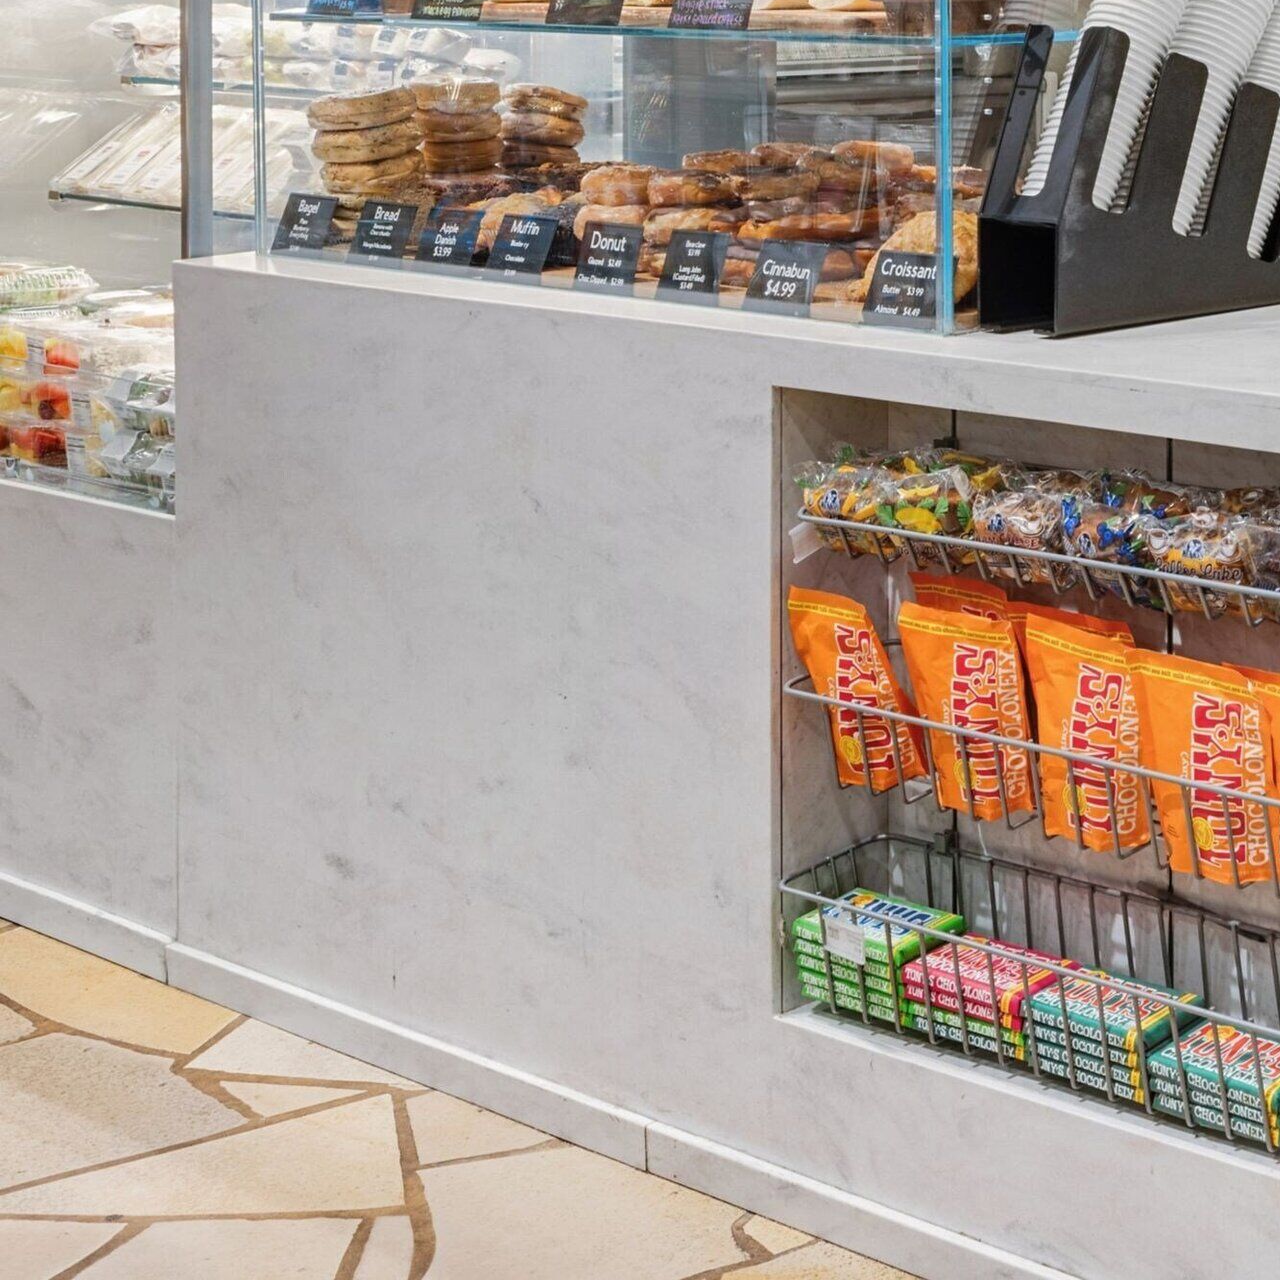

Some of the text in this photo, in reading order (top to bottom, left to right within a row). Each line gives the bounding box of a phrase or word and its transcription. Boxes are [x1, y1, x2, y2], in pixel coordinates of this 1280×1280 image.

[299, 200, 320, 217] Bagel
[374, 206, 400, 222] Bread
[439, 222, 459, 236] Apple
[510, 220, 540, 237] Muffin
[590, 232, 626, 252] Donut
[433, 247, 452, 258] $3.99
[763, 259, 810, 280] Cinnabun
[881, 259, 937, 280] Croissant
[764, 282, 797, 298] $4.99
